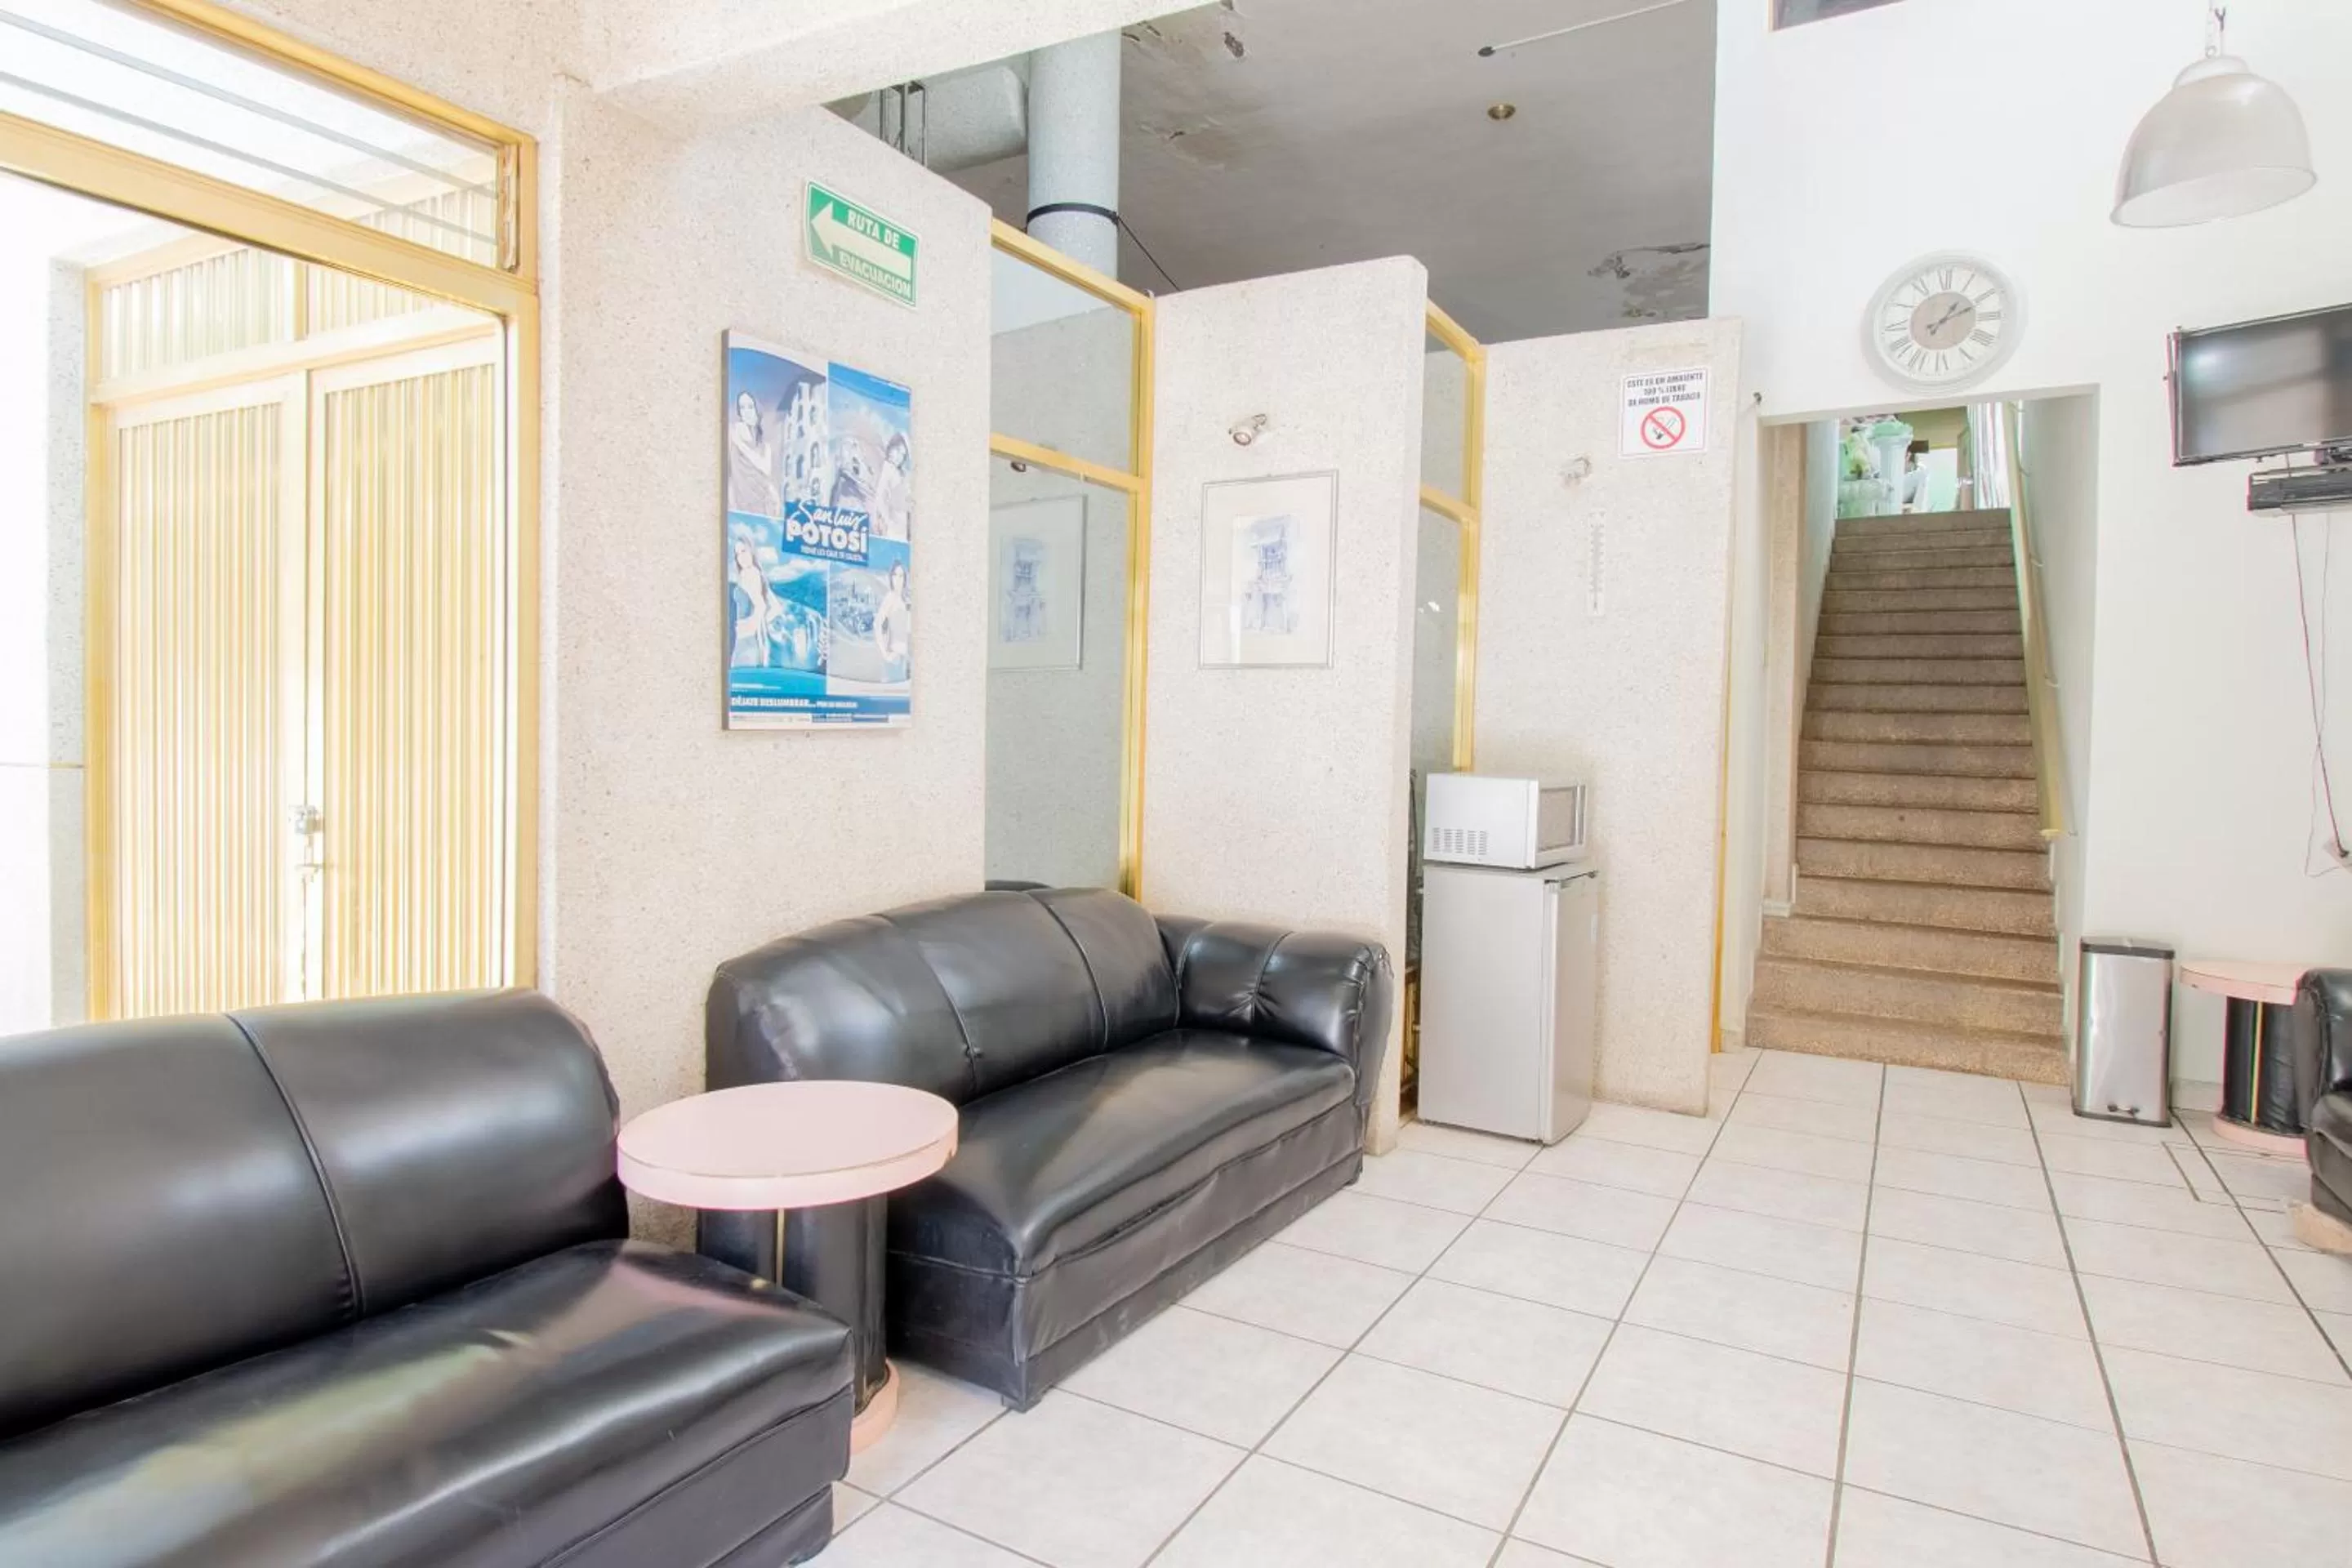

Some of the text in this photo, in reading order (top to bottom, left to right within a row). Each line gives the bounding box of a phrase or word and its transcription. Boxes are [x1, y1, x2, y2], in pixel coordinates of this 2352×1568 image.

[847, 210, 900, 250] RUTA DE
[838, 251, 911, 298] EVACUACION
[1627, 379, 1644, 388] ESTE
[1667, 372, 1703, 383] AMBIENTE
[1666, 384, 1686, 393] LIBRE
[1672, 391, 1700, 402] TABACO
[786, 519, 867, 553] POTOSÍ
